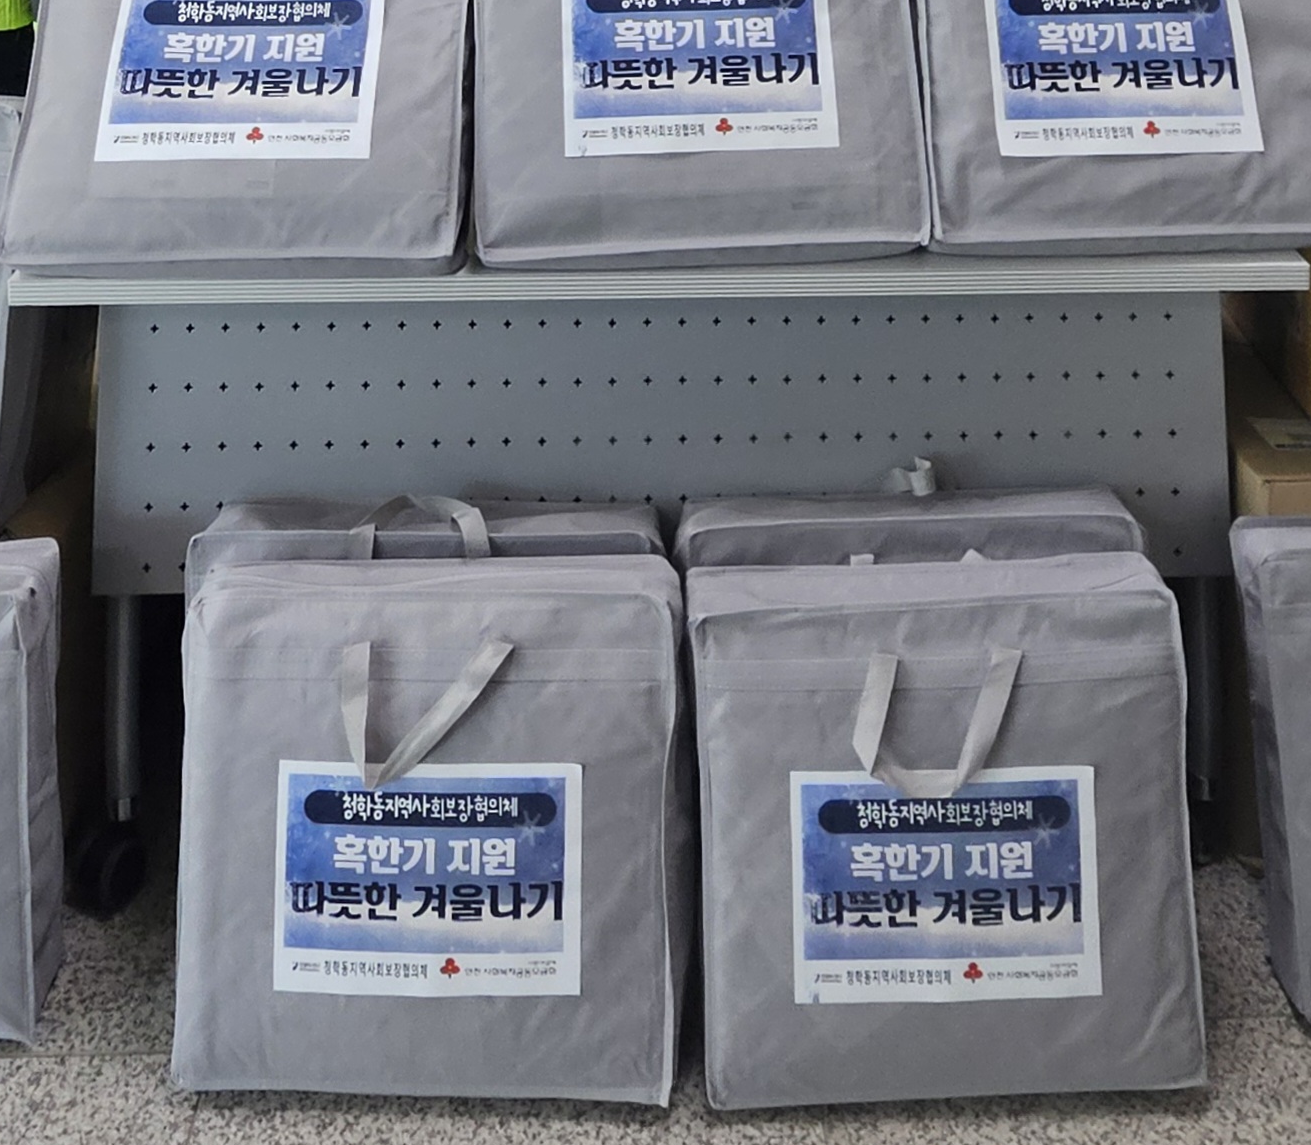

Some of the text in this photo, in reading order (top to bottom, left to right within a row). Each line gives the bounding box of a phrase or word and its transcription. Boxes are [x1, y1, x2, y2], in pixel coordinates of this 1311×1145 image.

[178, 2, 331, 23] 청학동지역사회보장협의체
[163, 32, 325, 63] 혹한기 지원
[614, 16, 776, 51] 혹한기 지원
[1038, 21, 1196, 55] 혹한기 지원
[119, 65, 363, 99] 따뜻한 겨울나기
[582, 52, 820, 90] 따뜻한 겨울나기
[1004, 57, 1240, 93] 따뜻한 겨울나기
[342, 791, 518, 822] 청학동지역사회보장협의체
[856, 798, 1034, 830] 청학동지역사회보장협의체
[332, 833, 517, 876] 혹한기 지원
[850, 840, 1034, 882] 혹한기 지원
[289, 880, 564, 922] 따뜻한 겨울나기
[810, 882, 1083, 928] 따뜻한 겨울나기
